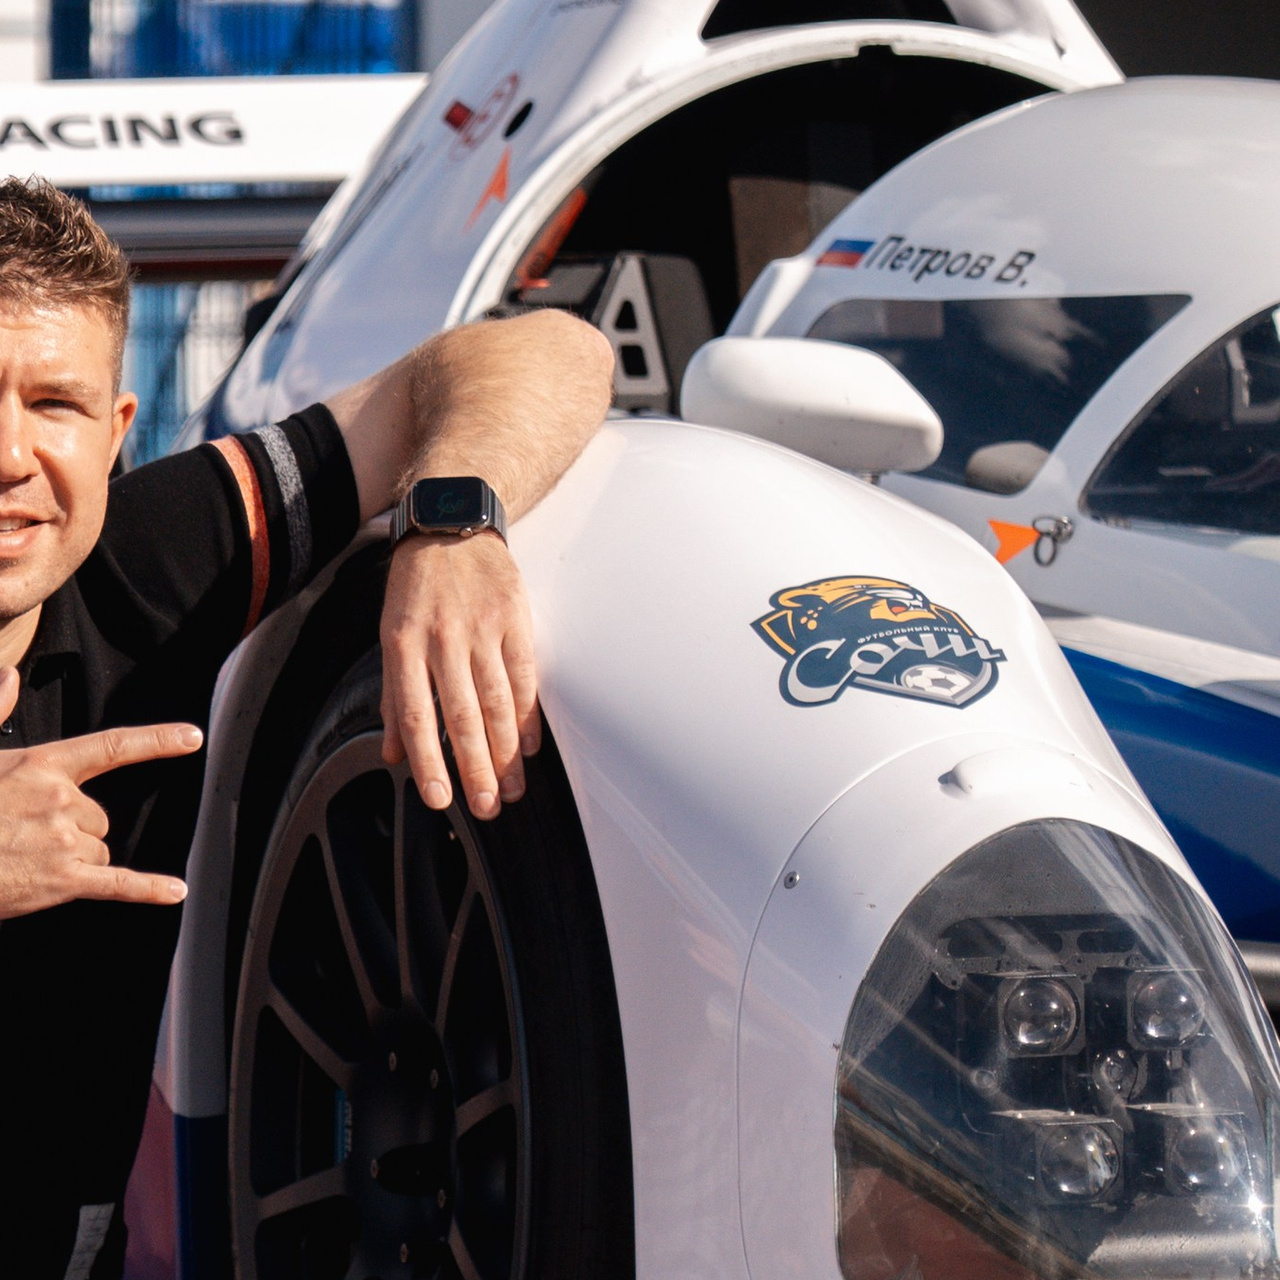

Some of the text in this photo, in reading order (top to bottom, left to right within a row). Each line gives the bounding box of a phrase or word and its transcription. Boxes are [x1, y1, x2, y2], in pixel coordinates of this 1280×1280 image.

[865, 235, 1038, 288] Петров В.
[857, 624, 960, 644] ФУТБОЛЬНЫЙ КЛУБ
